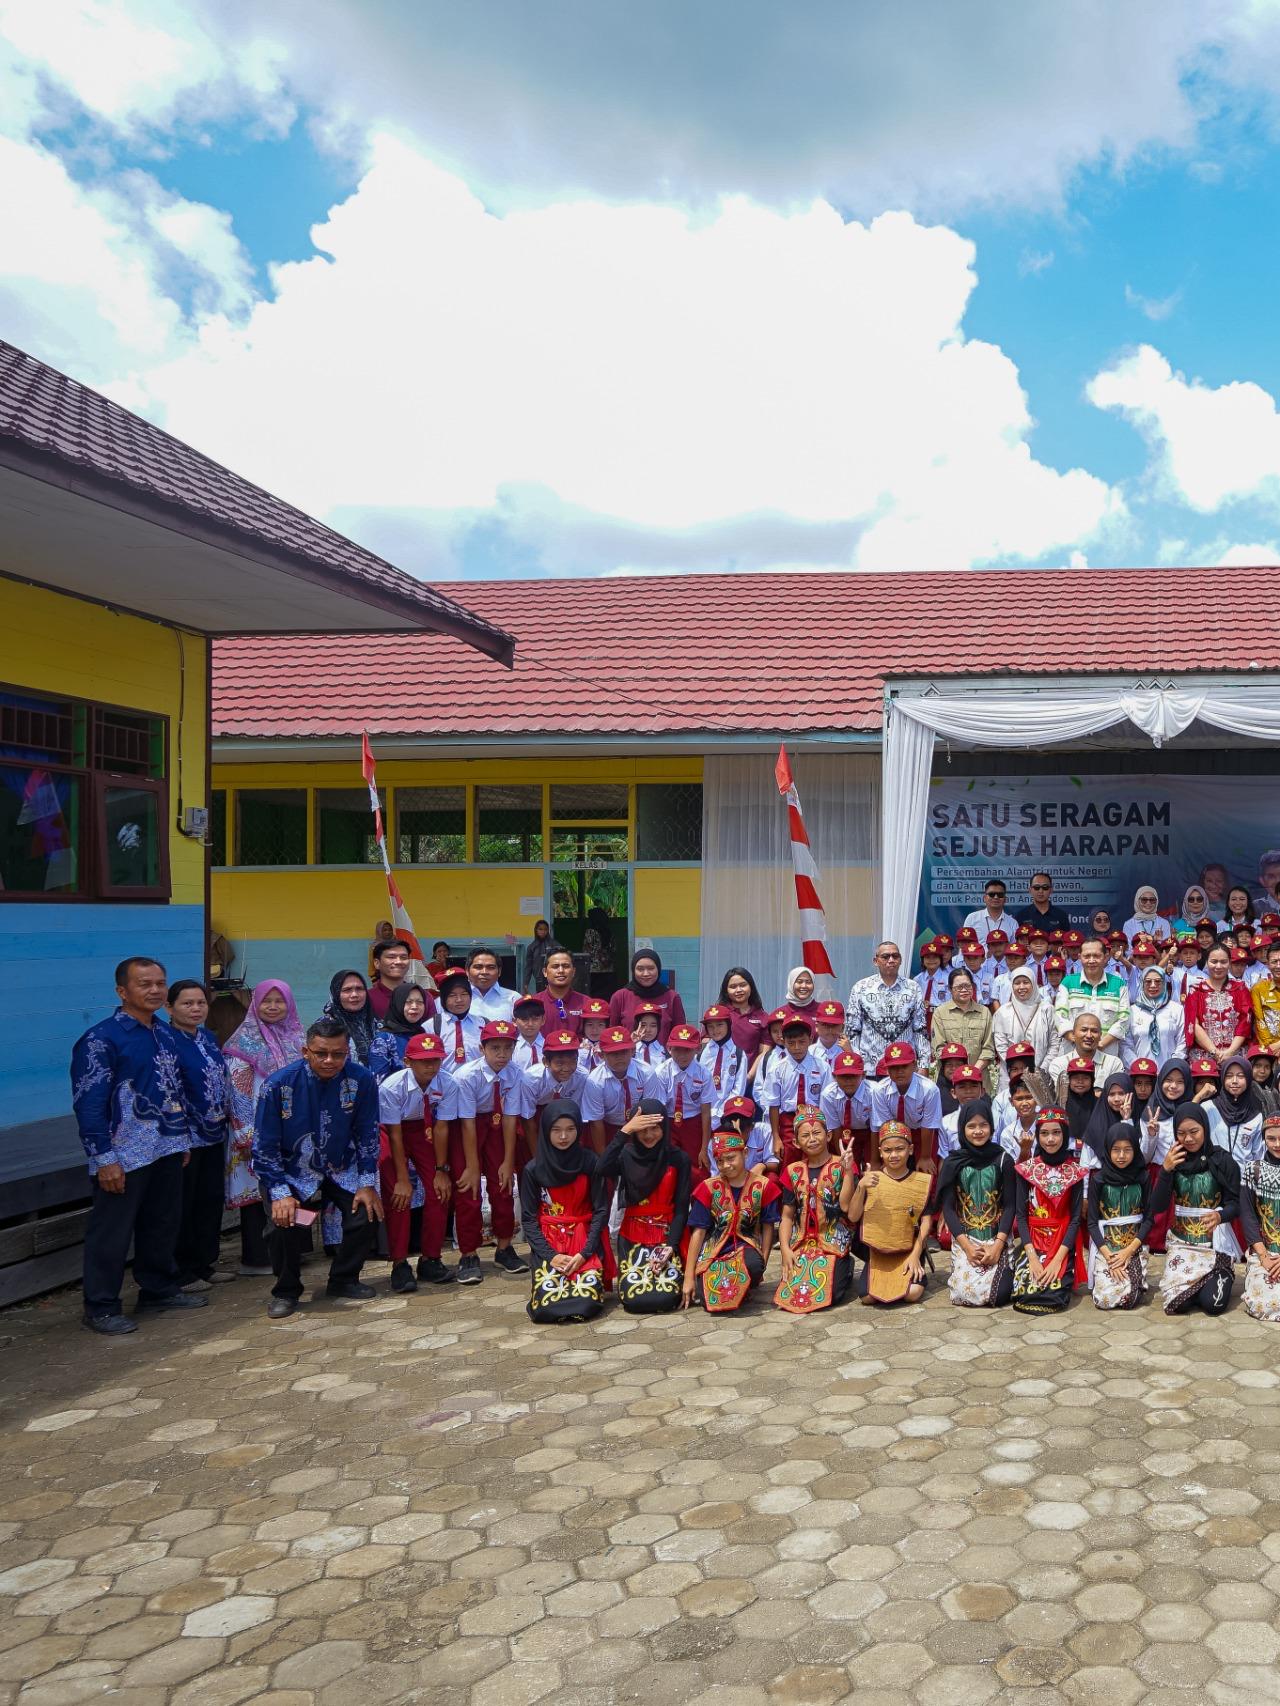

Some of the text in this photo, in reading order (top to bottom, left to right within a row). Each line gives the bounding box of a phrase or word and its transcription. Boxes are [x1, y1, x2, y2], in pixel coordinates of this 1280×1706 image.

[932, 802, 1171, 828] SATU SERAGAM
[932, 834, 1170, 857] SEJUTA HARAPAN
[937, 867, 1004, 876] Persembahan
[1047, 866, 1076, 876] untuk
[1078, 866, 1112, 879] Negeri
[937, 881, 954, 890] dan
[957, 881, 977, 890] Dari
[1009, 880, 1028, 890] Hati
[937, 894, 963, 904] untuk
